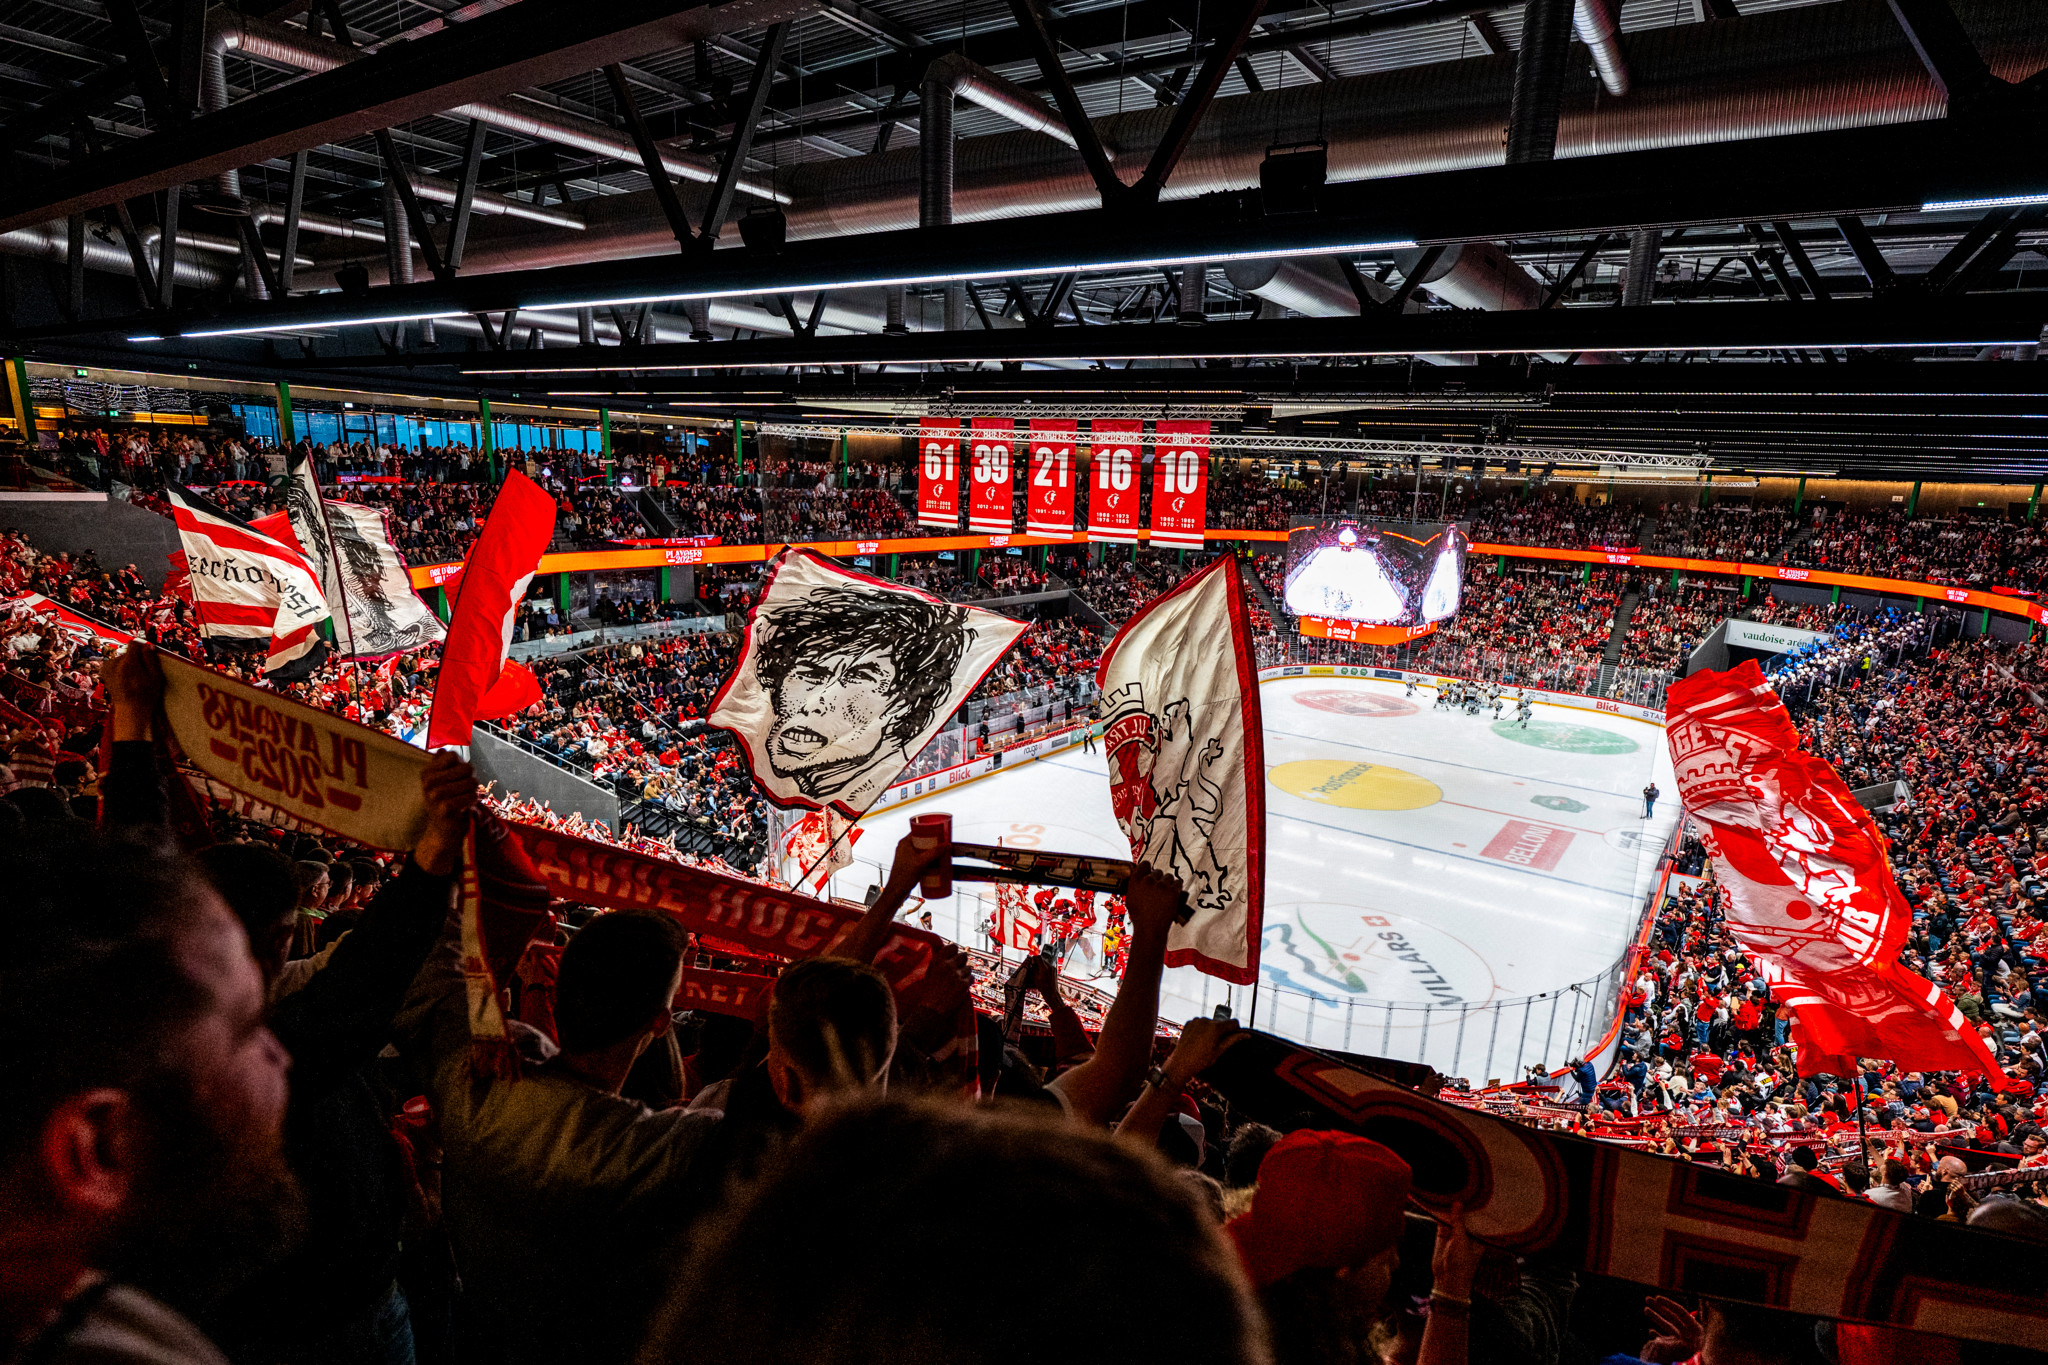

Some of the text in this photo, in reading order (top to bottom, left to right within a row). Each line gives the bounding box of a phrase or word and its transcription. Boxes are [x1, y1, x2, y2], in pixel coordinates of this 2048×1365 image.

[925, 442, 954, 480] 61
[974, 444, 1009, 484] 39
[1034, 446, 1069, 487] 21
[1095, 448, 1133, 491] 16
[1160, 450, 1199, 494] 10
[1332, 626, 1350, 636] 20:00
[1743, 632, 1785, 645] vaudoise
[1595, 701, 1620, 713] Blick
[949, 767, 971, 784] Blick
[1503, 825, 1553, 865] BELLONI
[1376, 931, 1464, 1006] VILLARS
